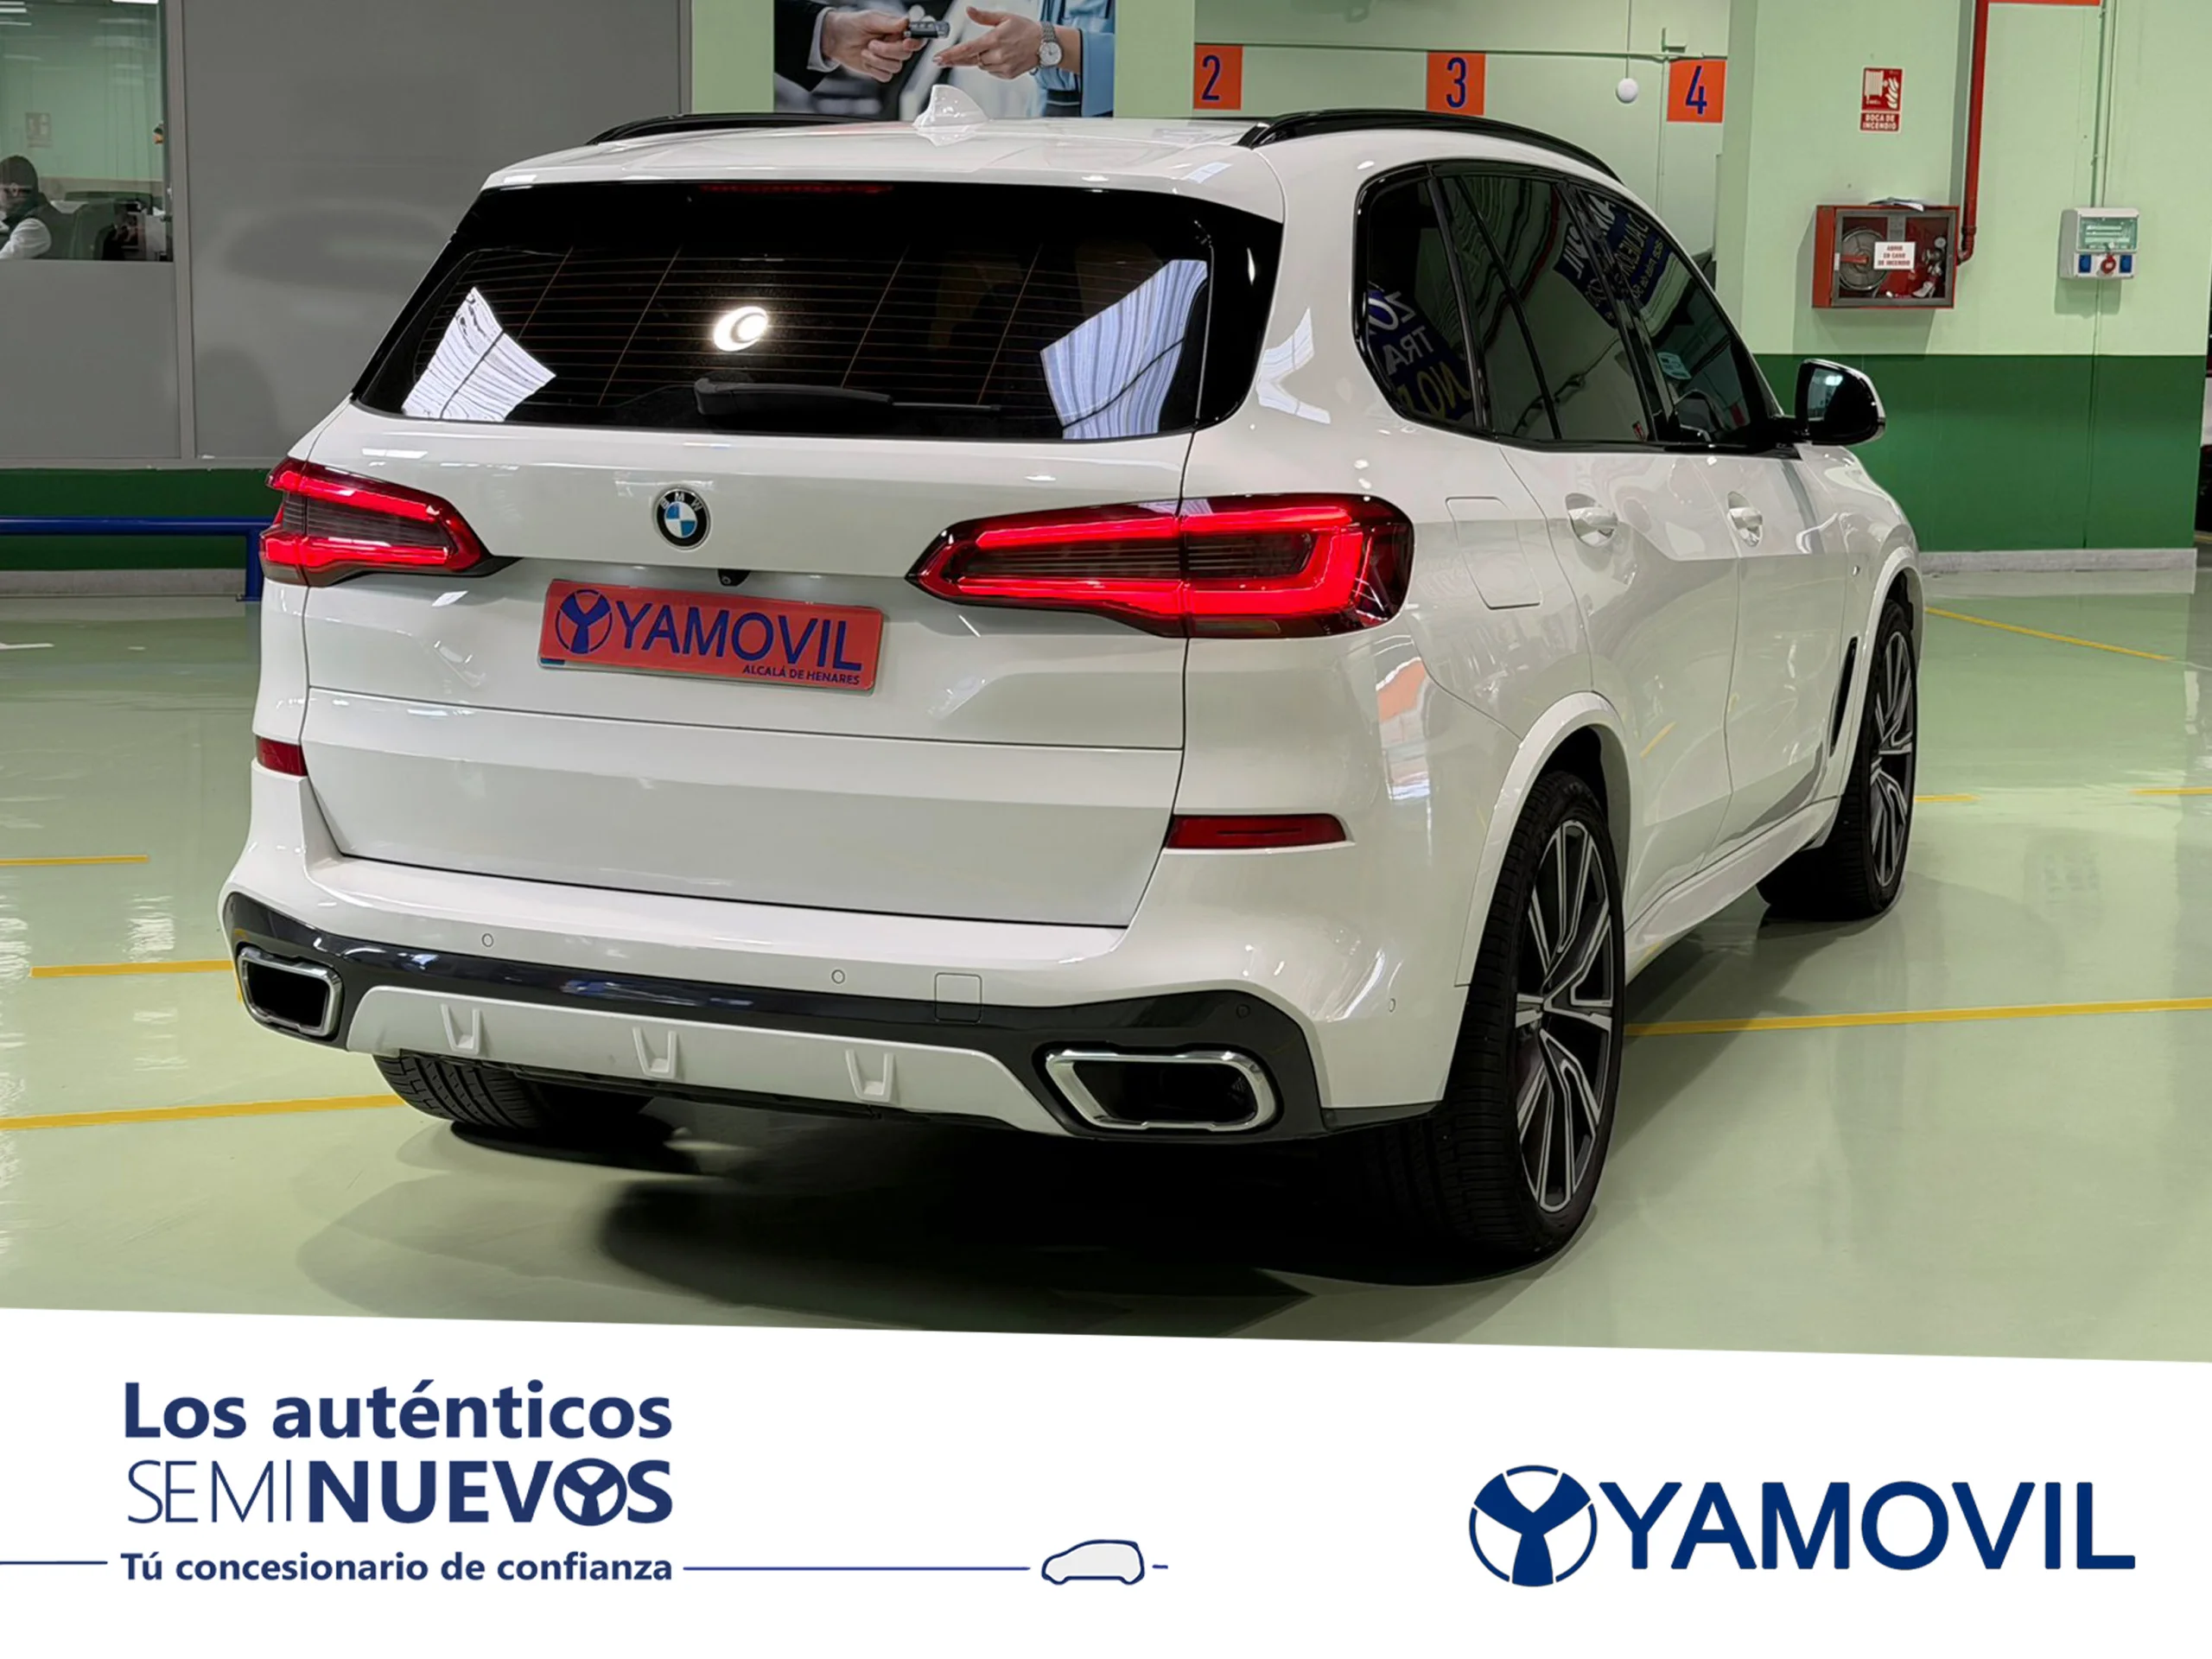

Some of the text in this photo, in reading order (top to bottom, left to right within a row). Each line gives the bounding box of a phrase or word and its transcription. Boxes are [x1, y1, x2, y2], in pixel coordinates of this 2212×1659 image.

[1202, 55, 1221, 101] 2
[1446, 57, 1467, 108] 3
[1685, 66, 1707, 115] 4
[659, 491, 704, 512] BMW
[616, 600, 863, 672] YAMOVIL
[742, 664, 861, 686] ALCALÁ DE HENARES
